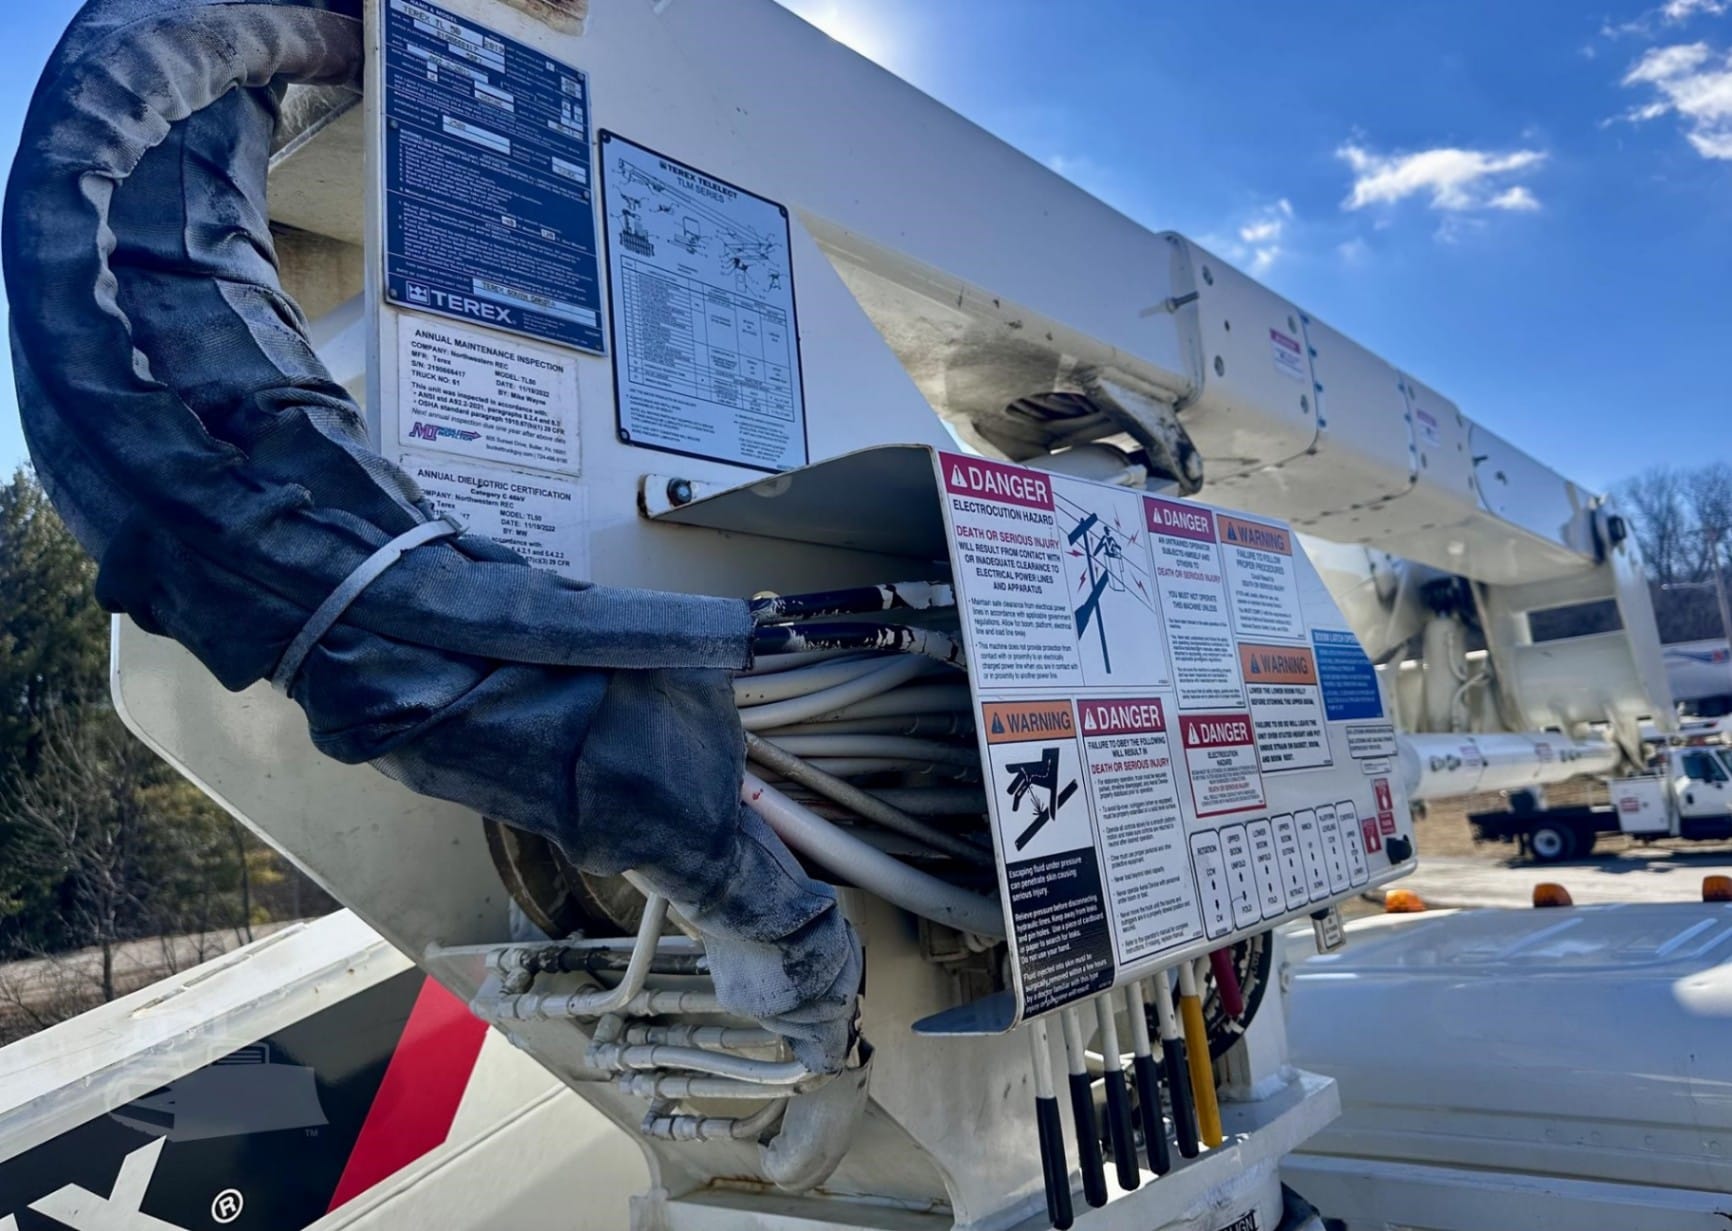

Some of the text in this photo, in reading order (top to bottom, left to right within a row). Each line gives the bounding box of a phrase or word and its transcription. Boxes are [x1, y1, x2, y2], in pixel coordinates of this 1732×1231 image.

[668, 164, 737, 199] TEREX TELELECT
[677, 176, 724, 203] TLM SERIES
[431, 290, 512, 324] TEREX
[411, 341, 508, 370] COMPANY: Northwestern REC
[415, 329, 564, 373] ANNUAL MAINTENANCE INSPECTION
[433, 355, 451, 365] Terex
[412, 369, 436, 381] TRUCK
[495, 370, 520, 381] MODEL:
[412, 381, 426, 390] This
[457, 392, 489, 403] inspected
[498, 402, 532, 413] accordance
[418, 391, 435, 400] ANSI
[488, 407, 522, 418] paragraphs
[511, 392, 525, 400] Mike
[526, 396, 546, 405] Wayne
[418, 399, 438, 409] OSHA
[440, 405, 469, 415] standard
[471, 411, 503, 422] paragraph
[418, 469, 571, 501] ANNUAL DIELECTRIC CERTIFICATION
[471, 489, 500, 499] Category
[968, 467, 1048, 503] DANGER
[423, 489, 514, 509] OMPANY: Northwestern REC
[437, 500, 455, 509] Terex
[500, 510, 525, 519] MODEL:
[953, 499, 1054, 525] ELECTROCUTION HAZARD
[1163, 508, 1209, 533] DANGER
[956, 525, 1059, 549] DEATH OR SERIOUS INJURY
[1238, 527, 1284, 550] WARNING
[958, 542, 1060, 561] WILL RESULT FROM CONTACT WITH
[965, 554, 1059, 573] OR INADEQUATE CLEARANCE TO
[976, 567, 1053, 583] ELECTRICAL POWER LINES
[1157, 567, 1221, 583] DEATH OR SERIOUS INJURY
[993, 582, 1042, 593] AND APPARATUS
[1261, 655, 1308, 674] WARNING
[1006, 711, 1071, 733] WARNING
[1097, 705, 1160, 730] DANGER
[1200, 722, 1248, 743] DANGER
[1088, 736, 1166, 750] FAILURE TO OBEY THE FOLLOWING
[1112, 749, 1124, 758] WILL
[1125, 748, 1141, 756] RESULT
[1091, 758, 1169, 774] DEATH OR SERIOUS INJURY
[1197, 845, 1217, 855] ROTATION
[1229, 847, 1242, 856] BOOM
[1008, 857, 1082, 879] Escaping fluid under pressure
[1010, 869, 1077, 890] can penetrate skin causing
[1012, 891, 1032, 902] serious
[1015, 895, 1097, 921] Relieve pressure before disconnecting
[1242, 904, 1252, 913] FOLD
